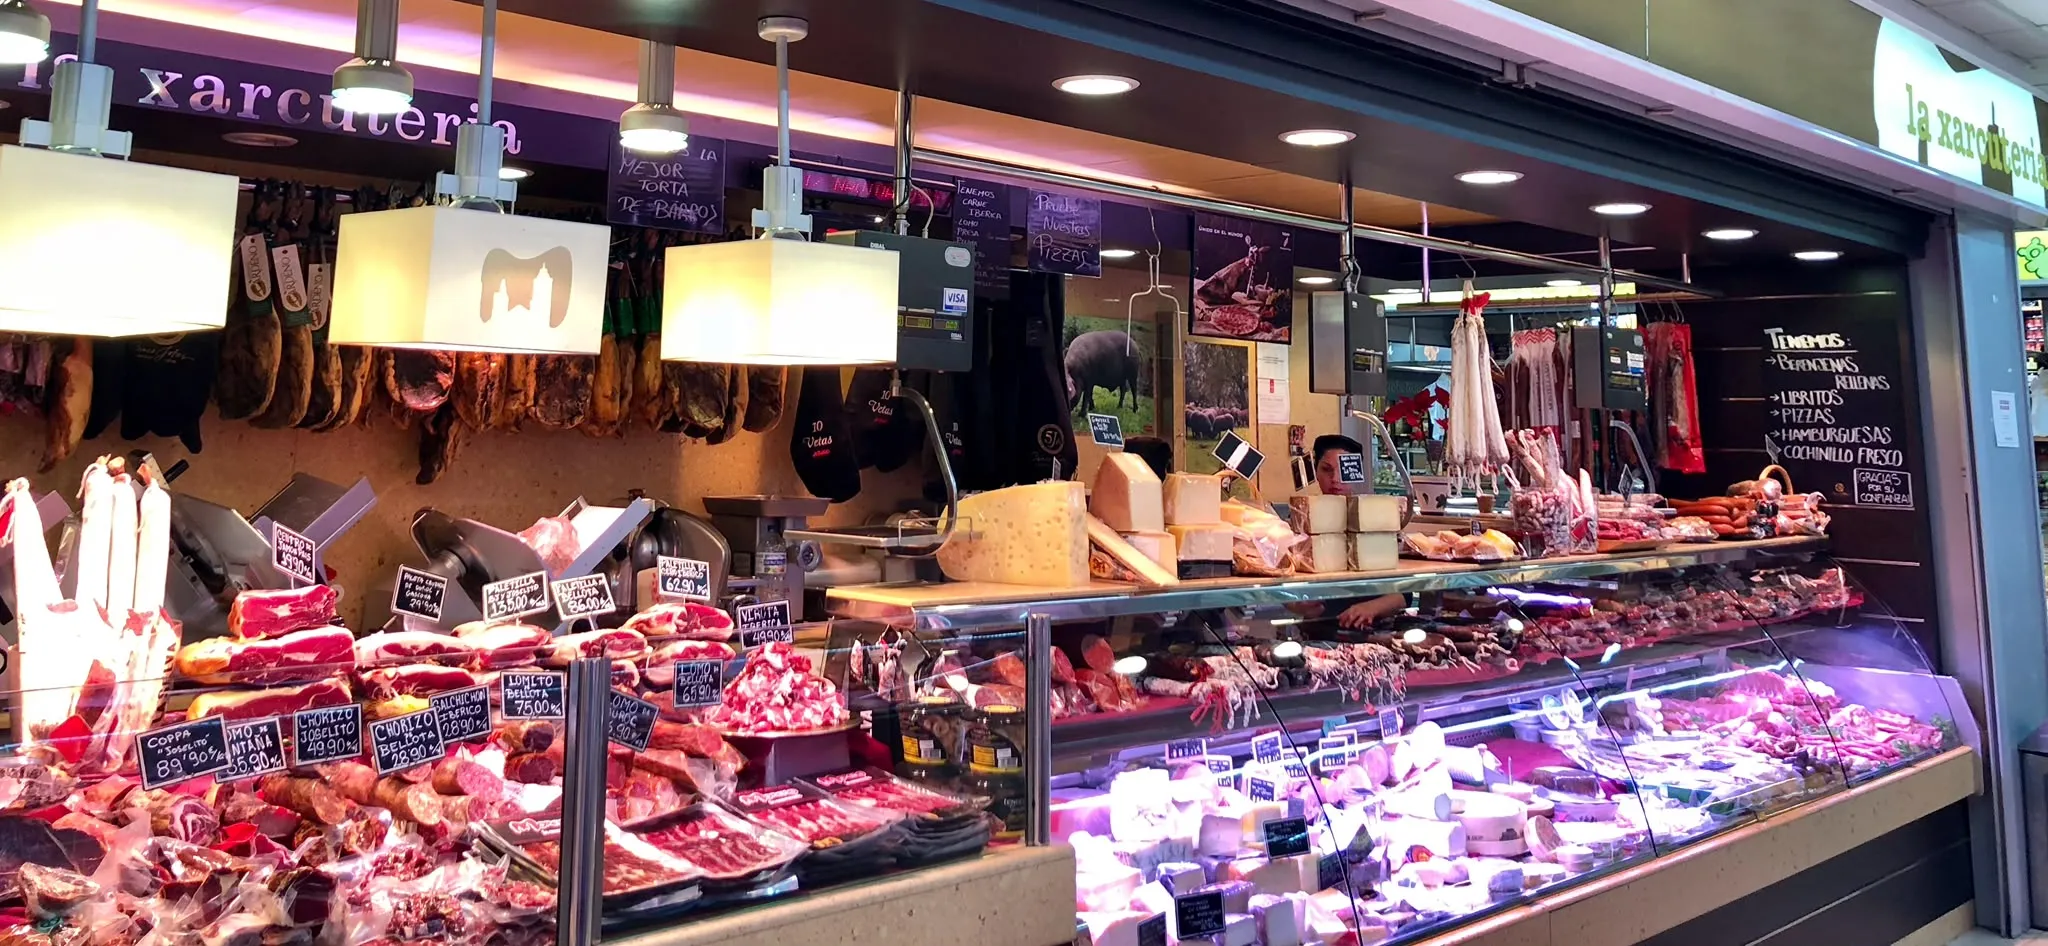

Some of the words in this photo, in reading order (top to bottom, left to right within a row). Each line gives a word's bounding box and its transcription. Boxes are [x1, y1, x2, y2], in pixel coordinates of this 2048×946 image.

[138, 67, 523, 155] xarcutera
[1905, 82, 1931, 142] la
[1936, 108, 2048, 189] xarcuteria
[700, 148, 717, 162] LA
[619, 158, 685, 179] MEJOR
[639, 179, 689, 197] TORTA
[957, 179, 996, 199] TENEMOS
[618, 196, 643, 213] DE
[1043, 215, 1091, 238] Nuestras
[947, 292, 966, 304] VISA
[1835, 374, 1890, 390] RELLENAS
[881, 390, 891, 401] 10
[1781, 389, 1844, 405] LIBRITOS
[868, 400, 893, 416] Vetas
[1782, 408, 1836, 424] PIZZAS
[812, 420, 823, 433] 10
[1782, 426, 1892, 445] HAMBURGUESAS
[803, 435, 833, 448] Vetas
[1783, 445, 1853, 463] COCHINILLO
[1857, 447, 1903, 467] FRESCO
[1858, 472, 1901, 486] GRACIAS
[1868, 484, 1882, 492] POR
[487, 577, 536, 597] PALETILLA
[678, 663, 711, 677] LOMO
[508, 675, 554, 688] LOMITO
[677, 674, 714, 687] BELLOTA
[505, 688, 549, 700] BELLOTA
[611, 695, 639, 714] OMO
[298, 708, 354, 729] CHORIZO
[439, 705, 482, 723] IBERICO
[609, 708, 638, 727] UROC
[300, 721, 355, 743] JOSELITO
[374, 712, 434, 741] CHORIZO
[147, 729, 191, 749] COPPA
[231, 733, 274, 757] NTAÑA
[378, 730, 436, 758] BELLOTA
